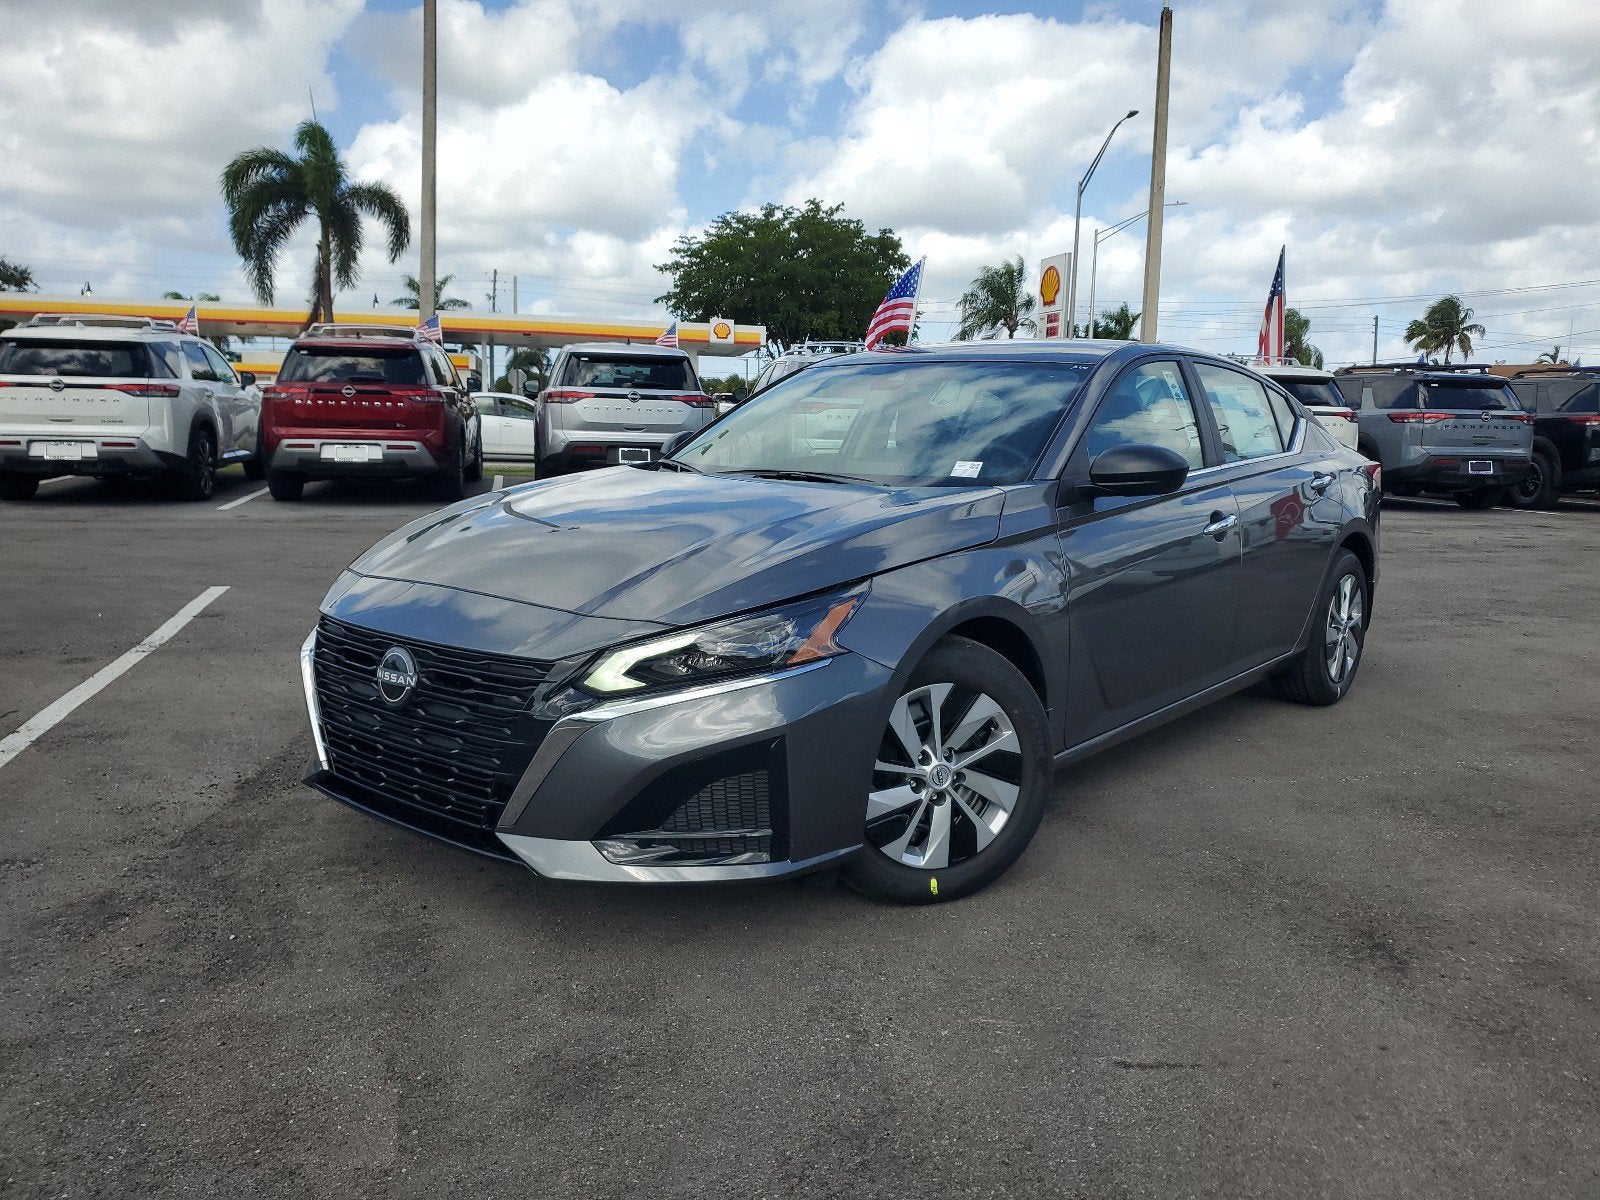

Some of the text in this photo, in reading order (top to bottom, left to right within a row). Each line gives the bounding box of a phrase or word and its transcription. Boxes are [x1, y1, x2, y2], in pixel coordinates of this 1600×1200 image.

[294, 399, 406, 407] PATHFINDER
[583, 405, 684, 413] PATHFINDER
[376, 668, 416, 686] NISSAN
